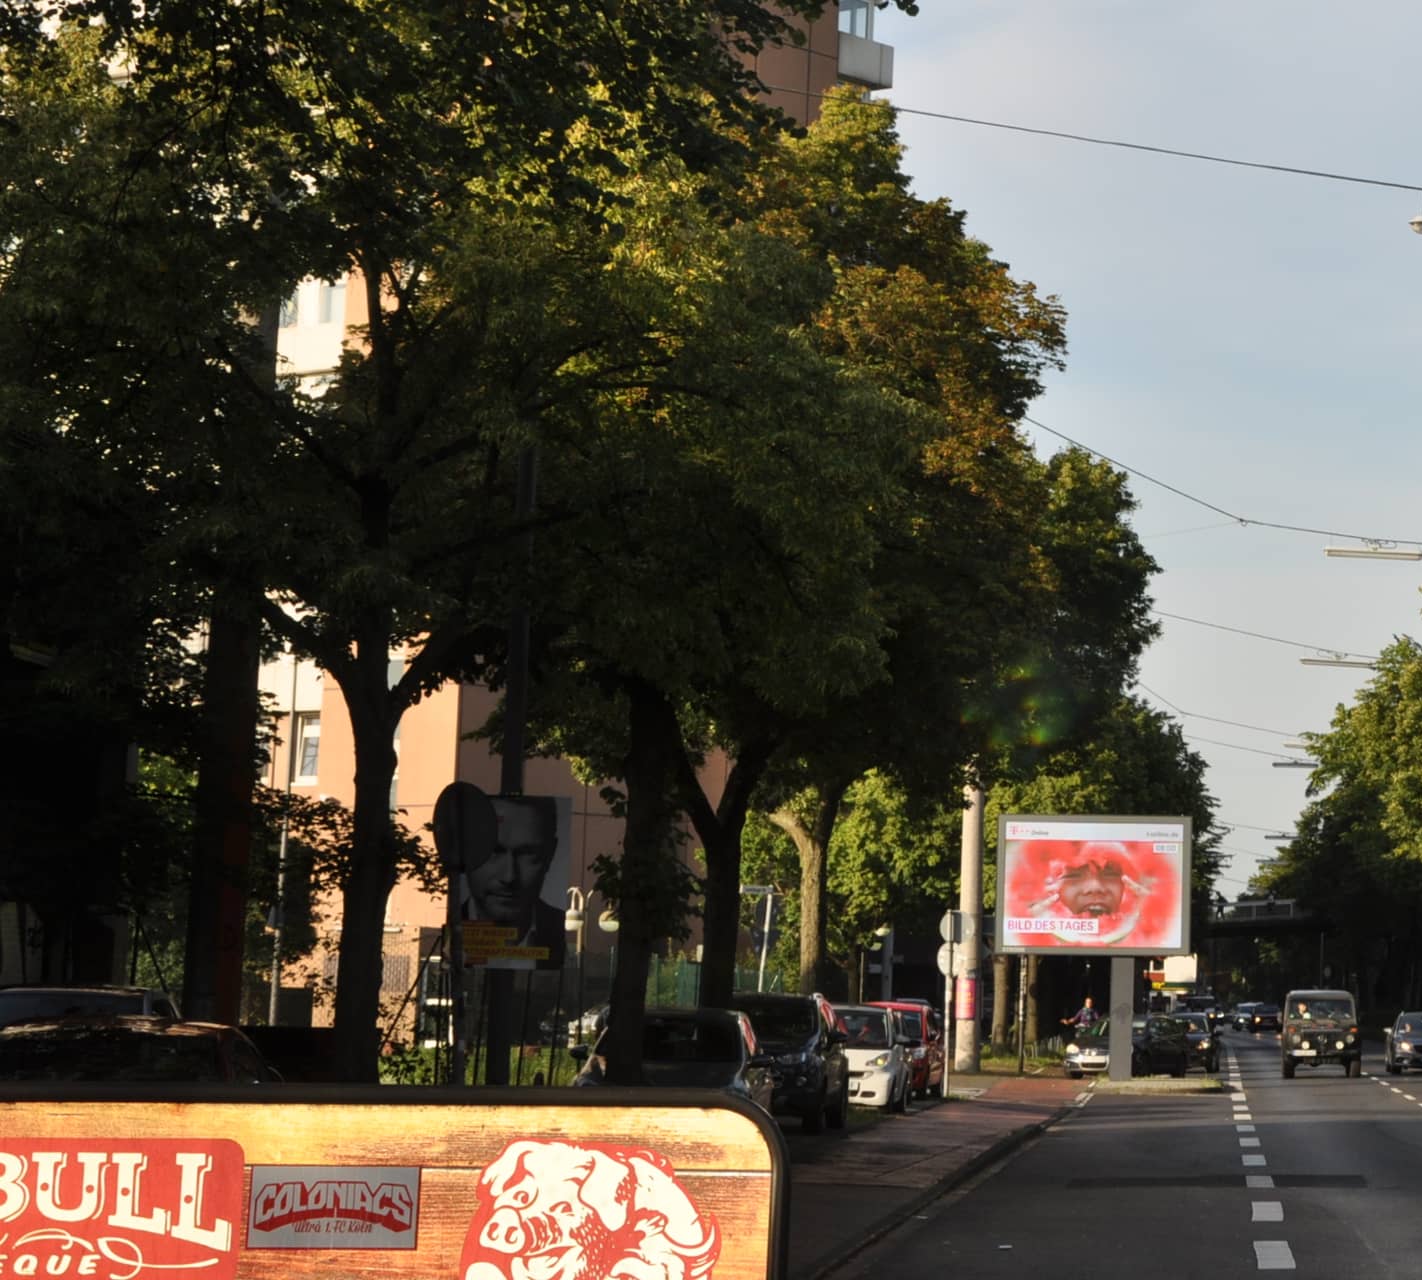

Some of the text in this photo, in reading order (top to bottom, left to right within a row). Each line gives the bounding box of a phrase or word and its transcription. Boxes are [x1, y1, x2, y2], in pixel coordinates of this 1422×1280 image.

[1007, 919, 1094, 931] BILD DES TAGES
[254, 1181, 413, 1232] COLONIACS
